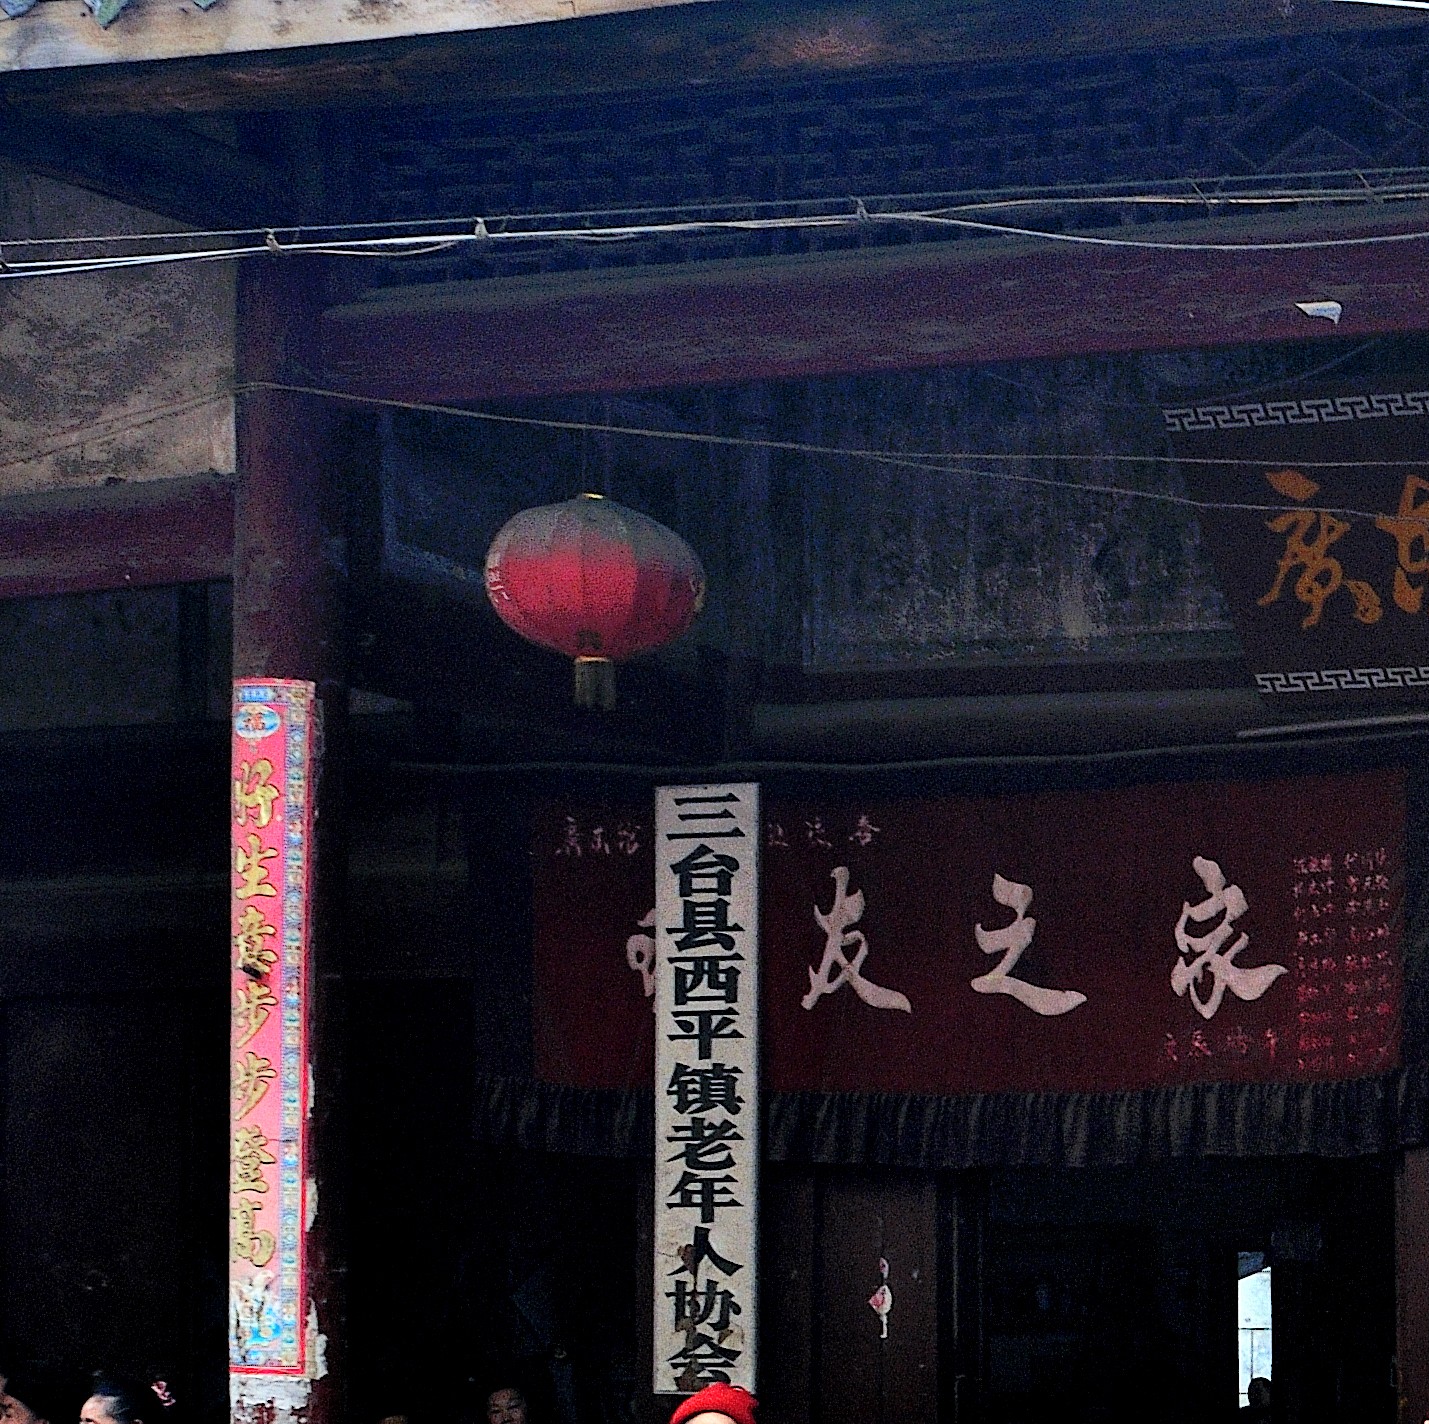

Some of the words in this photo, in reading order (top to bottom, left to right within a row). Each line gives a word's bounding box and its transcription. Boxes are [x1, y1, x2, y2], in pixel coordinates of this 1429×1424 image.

[665, 791, 747, 1392] 三台县西平镇老年人协会
